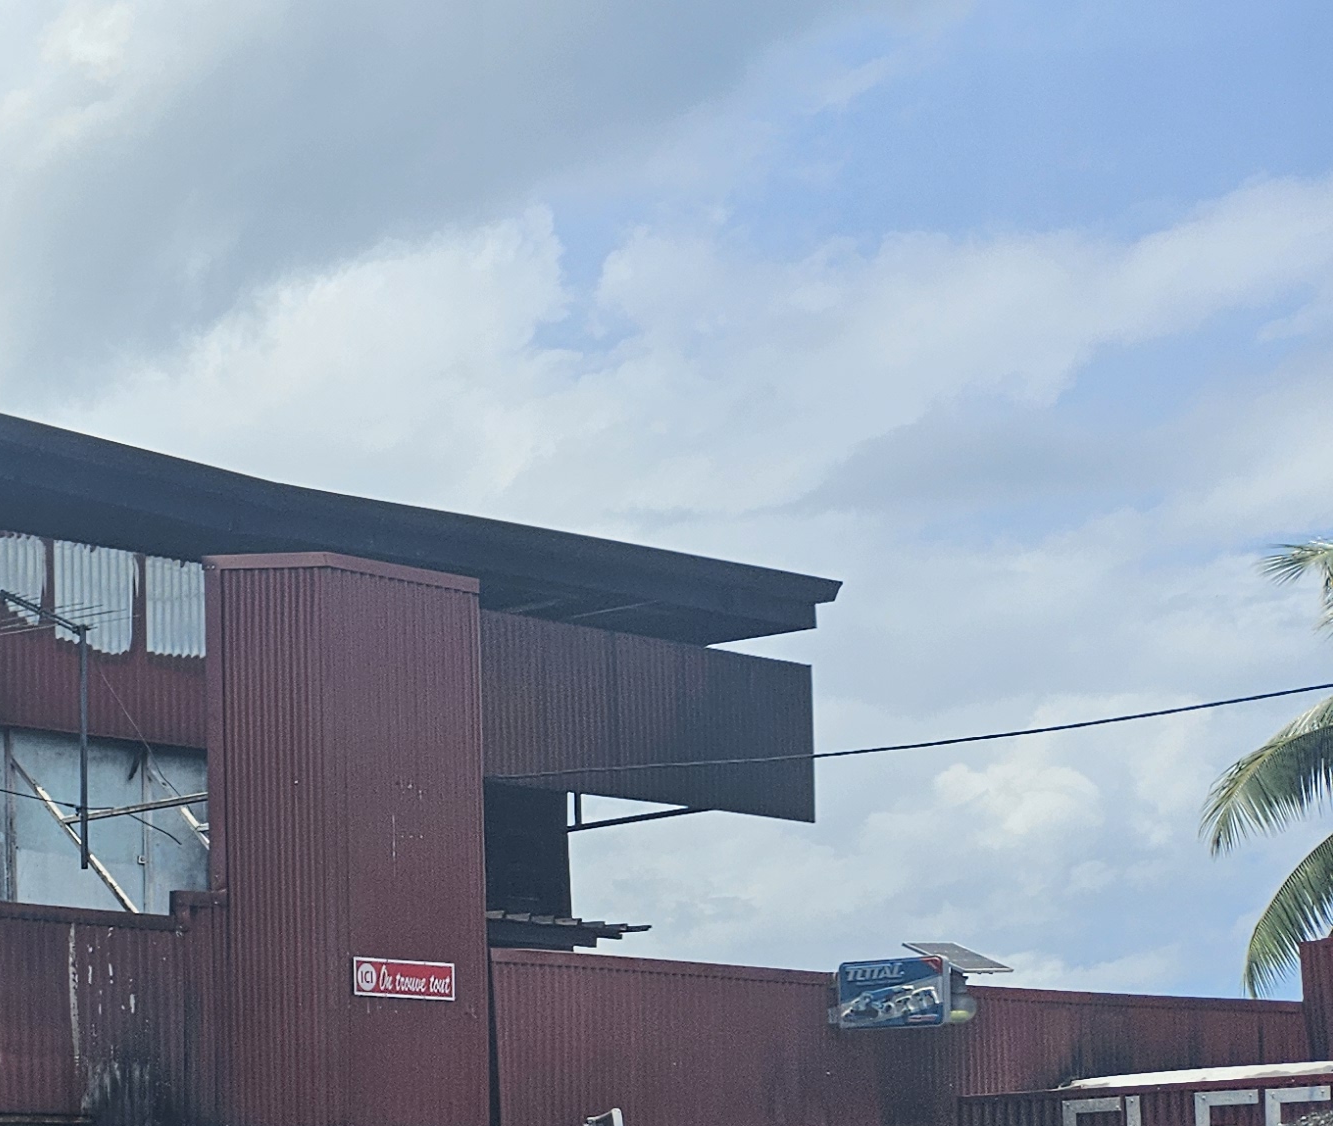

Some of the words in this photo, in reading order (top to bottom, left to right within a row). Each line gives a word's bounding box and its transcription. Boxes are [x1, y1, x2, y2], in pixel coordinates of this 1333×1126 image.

[360, 970, 374, 984] ICI
[379, 964, 393, 991] On
[429, 974, 451, 994] tout
